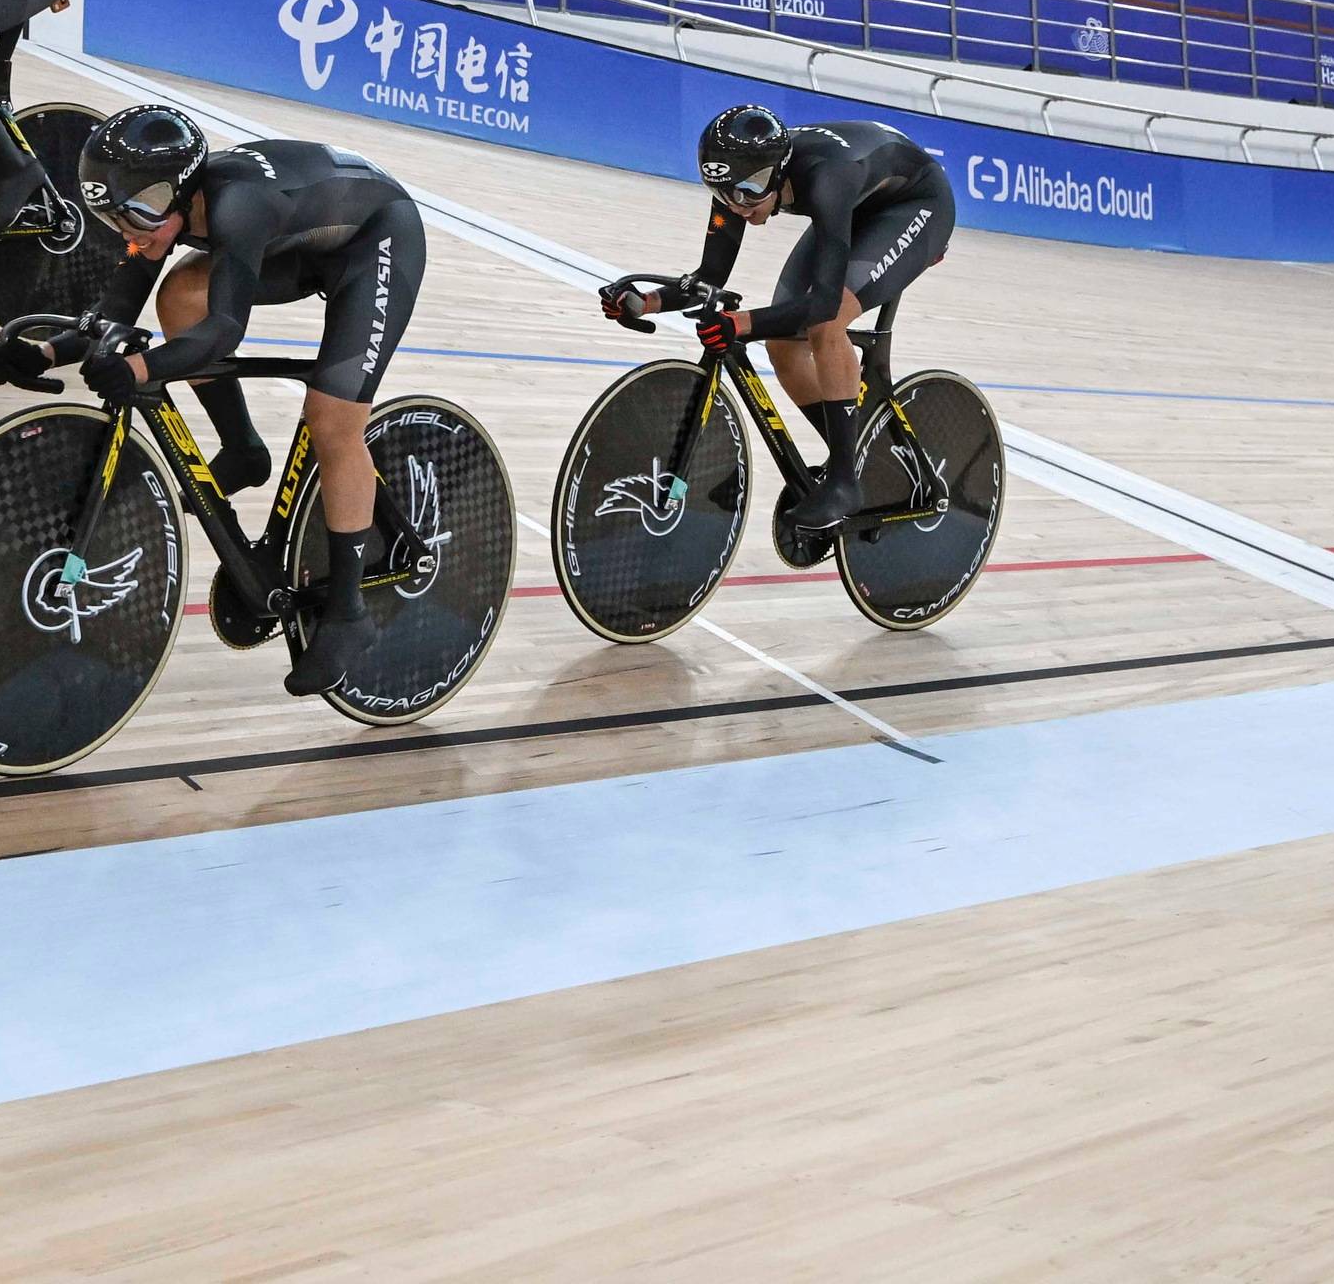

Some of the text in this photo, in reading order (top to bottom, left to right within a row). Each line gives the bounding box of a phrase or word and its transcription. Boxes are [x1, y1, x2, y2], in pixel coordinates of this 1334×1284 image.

[365, 6, 533, 103] 中国电信
[362, 82, 529, 134] CHINA TELECOM
[1013, 164, 1153, 221] Alibaba Cloud
[869, 208, 933, 283] MALAYSIA
[361, 236, 392, 375] MALAYSIA
[276, 423, 312, 519] ULTRA
[364, 411, 467, 446] GHIBLI
[142, 470, 179, 629] GHIBLI
[567, 441, 592, 577] GHIBLI
[894, 463, 1000, 620] CAMPAGNOLO
[339, 606, 495, 711] AMPAGNOLO
